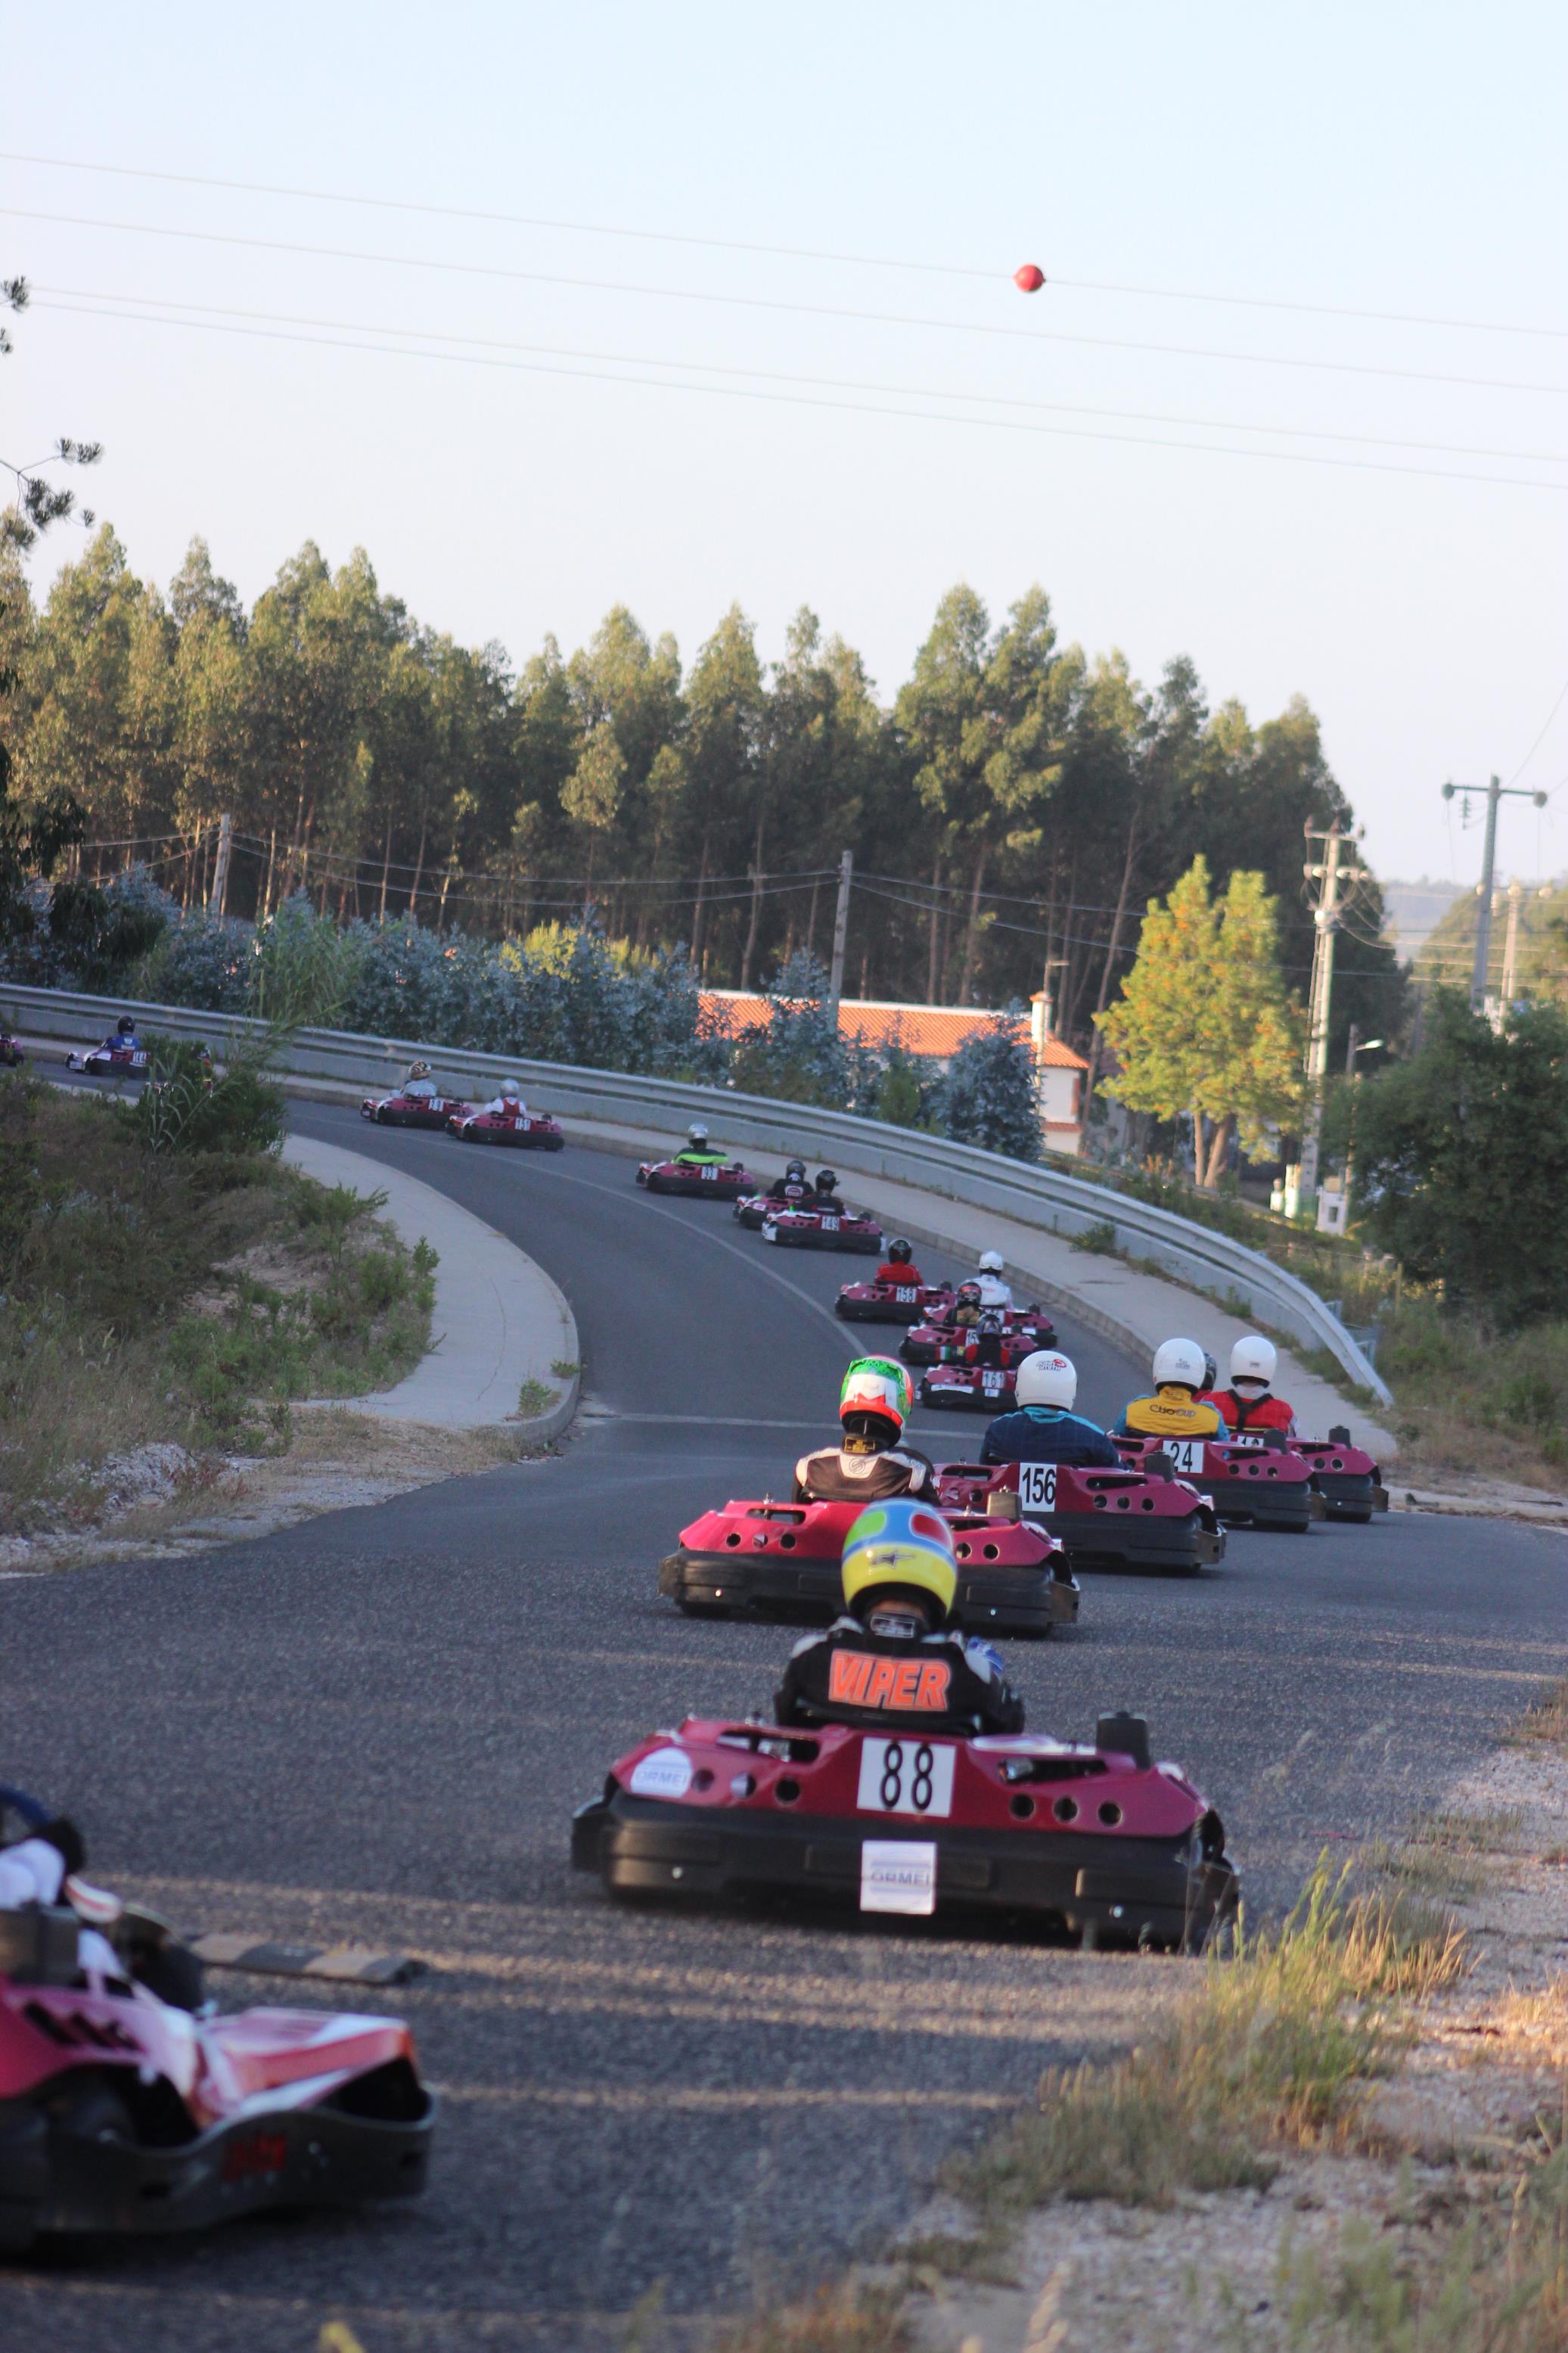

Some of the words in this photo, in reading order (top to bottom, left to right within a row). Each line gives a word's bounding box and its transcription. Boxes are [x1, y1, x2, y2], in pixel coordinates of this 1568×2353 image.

[898, 1288, 914, 1303] 158
[1170, 1441, 1193, 1472] 24
[1022, 1466, 1057, 1505] 156
[830, 1649, 950, 1711] VIPER
[880, 1740, 934, 1811] 88
